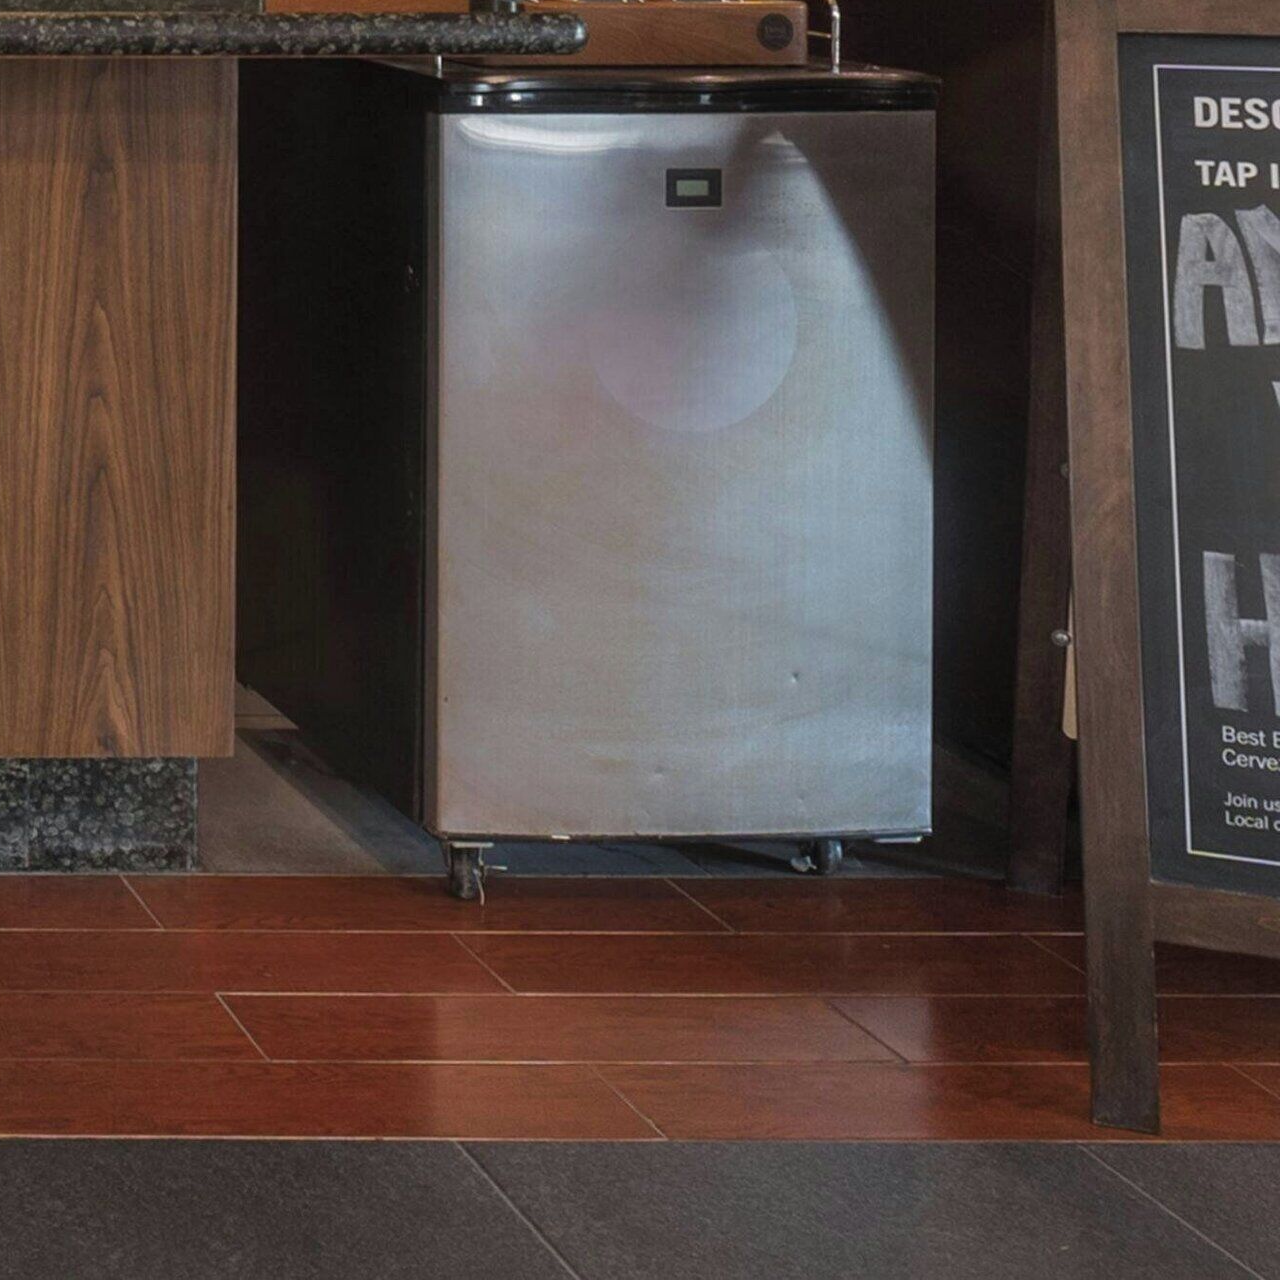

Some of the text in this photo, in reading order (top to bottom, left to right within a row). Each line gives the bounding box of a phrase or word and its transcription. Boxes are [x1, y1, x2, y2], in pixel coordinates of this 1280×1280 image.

[1194, 160, 1258, 188] TAP
[1222, 725, 1266, 747] Best
[1222, 748, 1280, 772] Cerve
[1224, 792, 1258, 809] Join
[1225, 810, 1269, 830] Local
